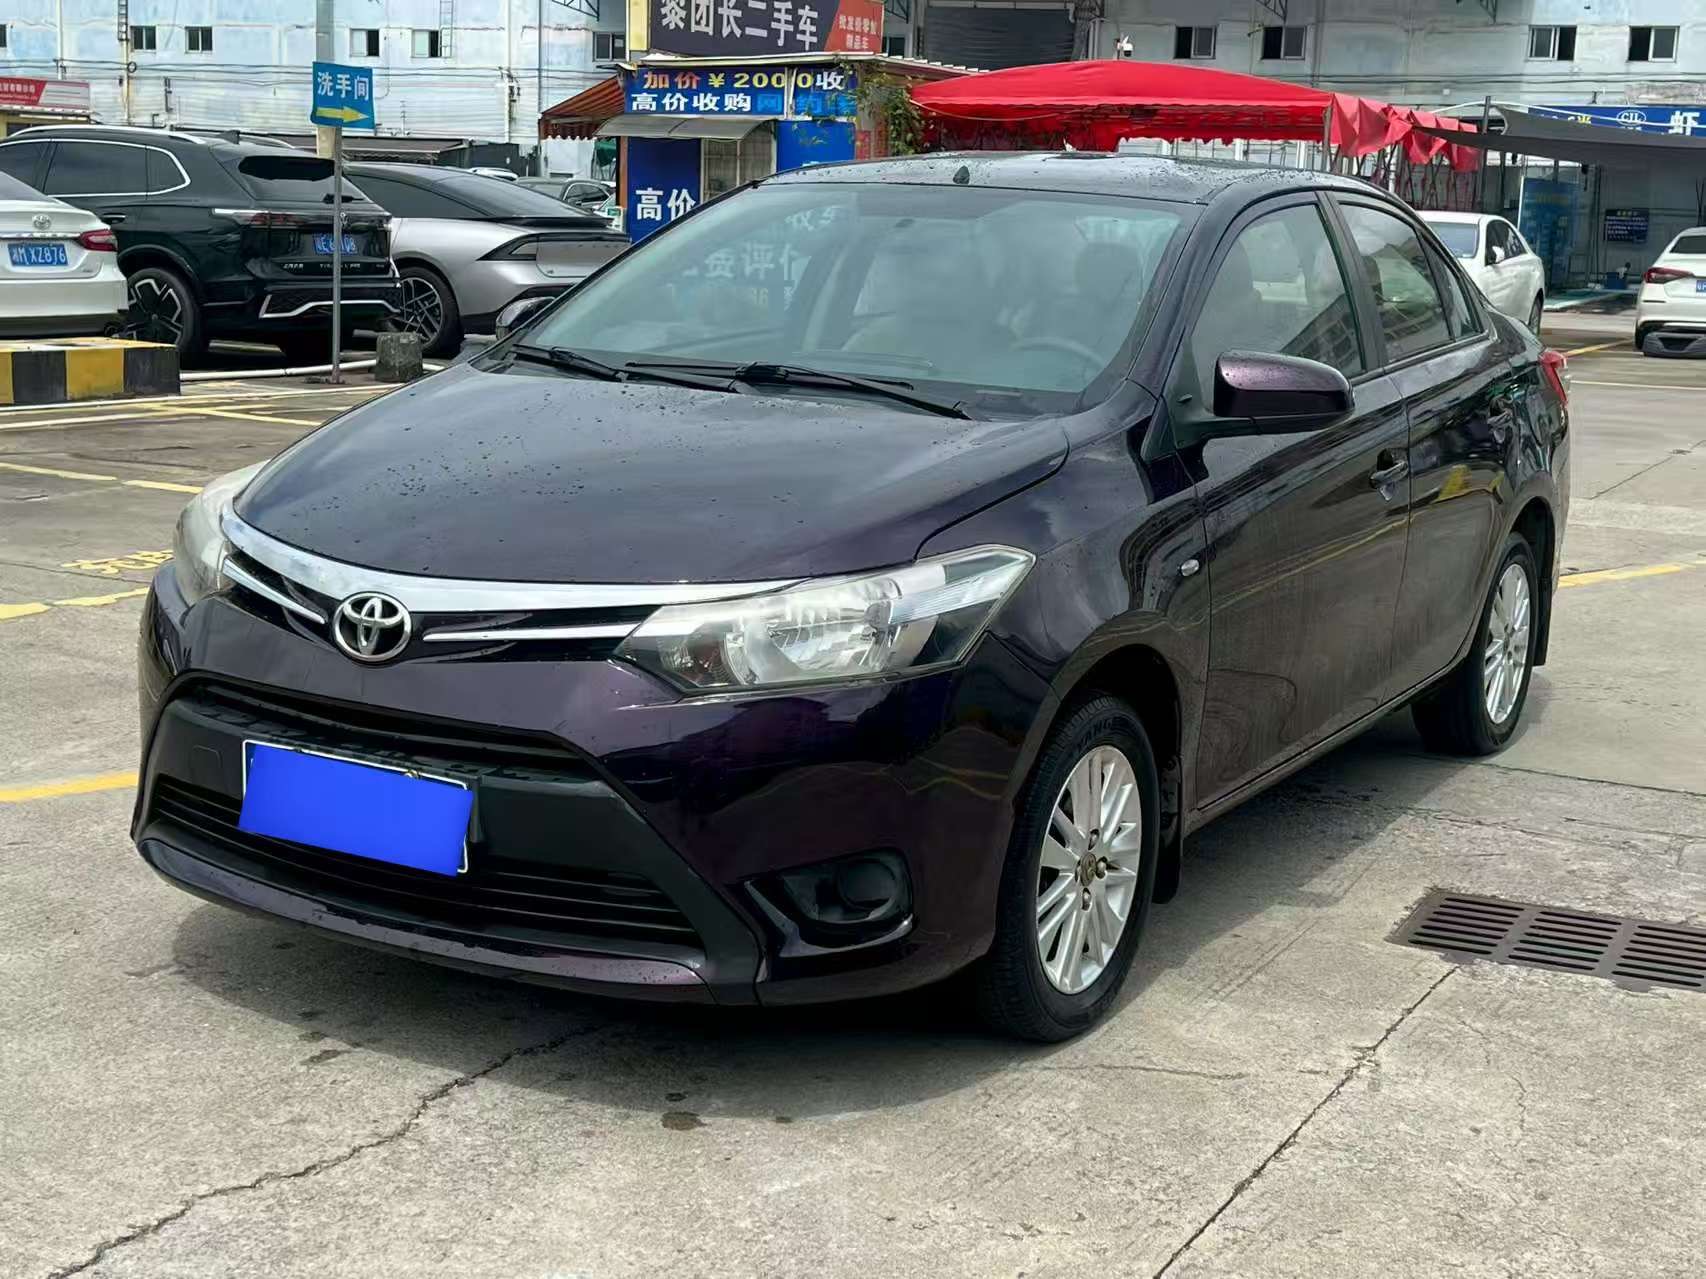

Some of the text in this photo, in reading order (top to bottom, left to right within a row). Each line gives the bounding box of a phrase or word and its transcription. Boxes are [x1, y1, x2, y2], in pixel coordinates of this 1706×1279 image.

[317, 71, 369, 101] 洗手间
[635, 187, 696, 221] 高价
